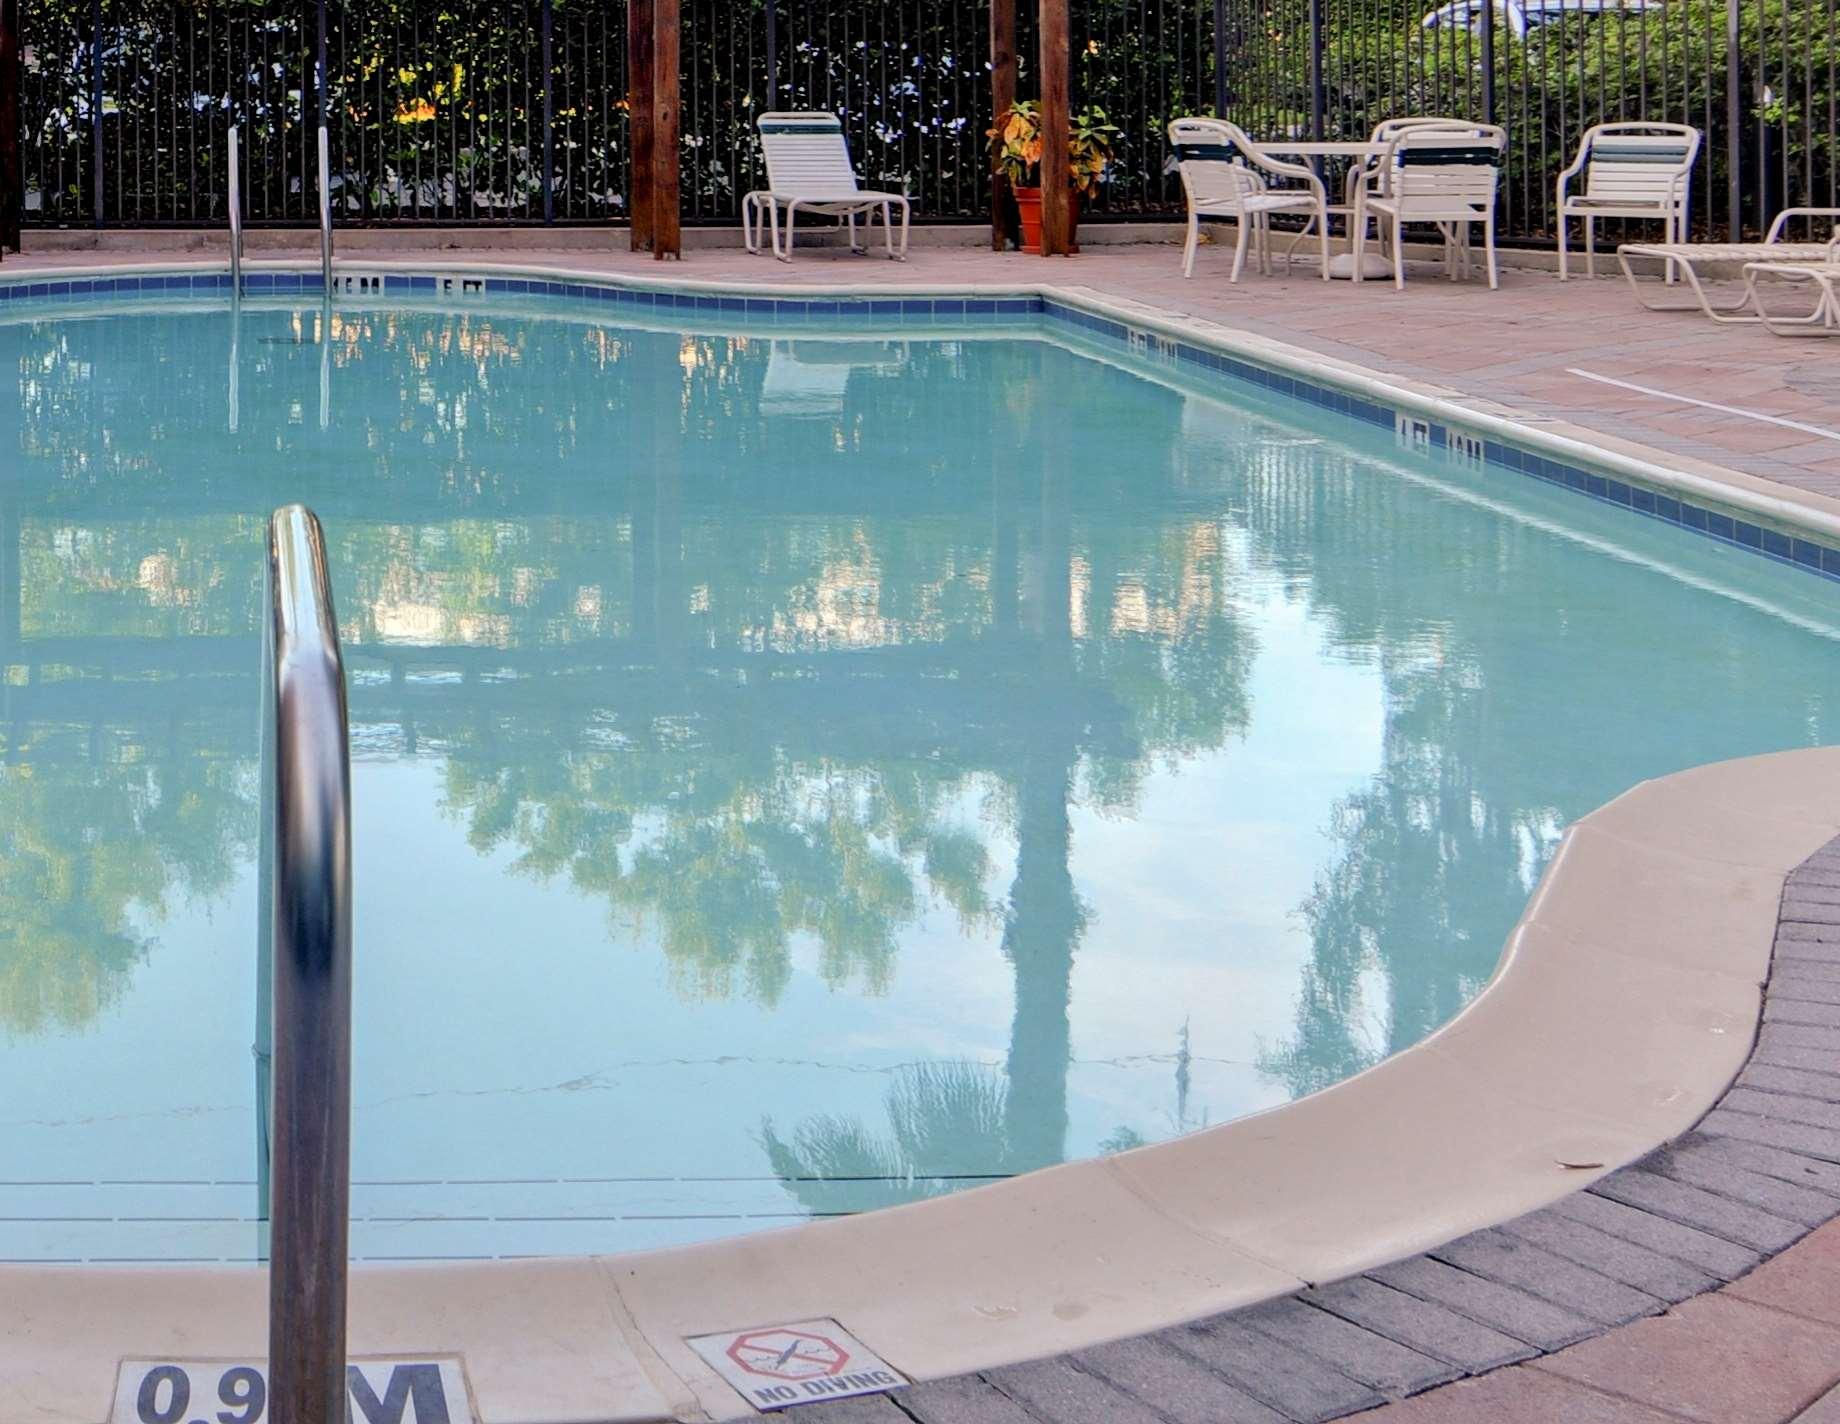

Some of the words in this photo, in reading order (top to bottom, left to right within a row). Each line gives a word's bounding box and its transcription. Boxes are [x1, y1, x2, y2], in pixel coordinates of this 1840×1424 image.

[346, 1363, 450, 1424] M
[754, 1385, 799, 1404] NO
[800, 1370, 898, 1396] DIVING
